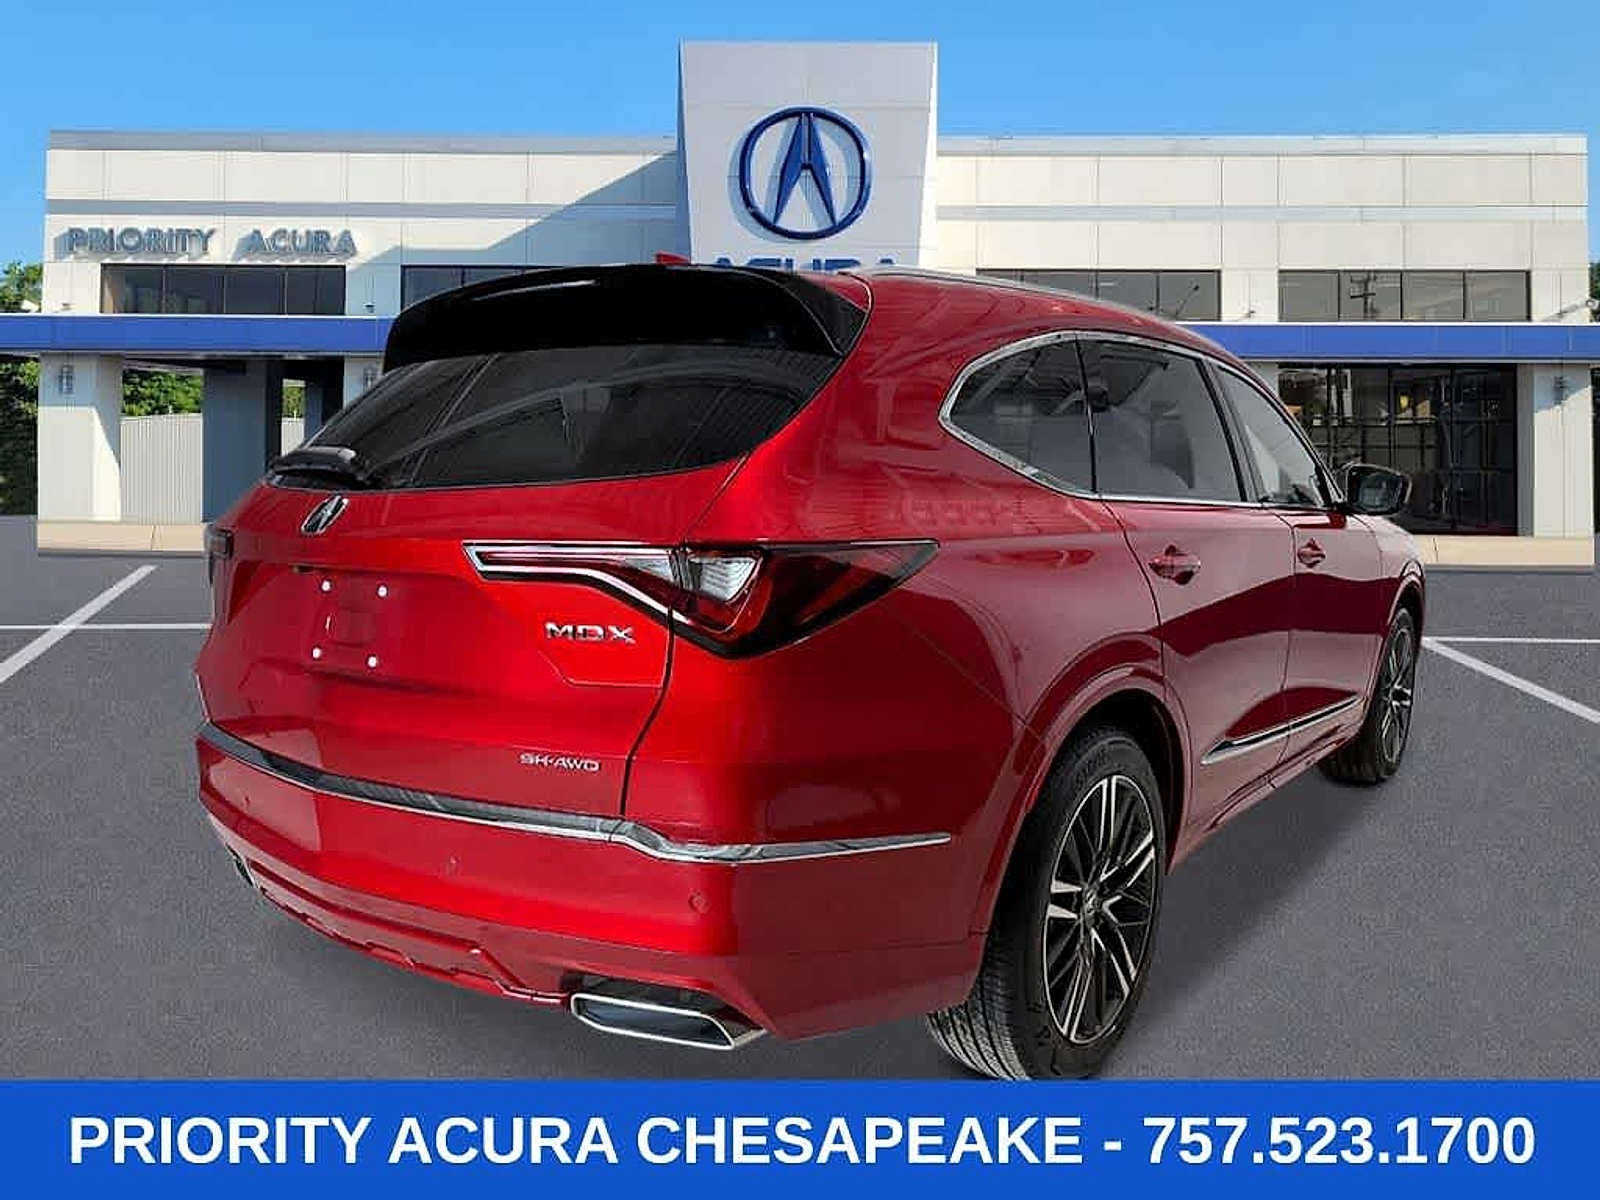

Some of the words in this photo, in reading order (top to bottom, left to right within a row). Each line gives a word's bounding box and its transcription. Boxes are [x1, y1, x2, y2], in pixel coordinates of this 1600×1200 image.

[67, 227, 215, 253] PRIORITY
[247, 229, 357, 254] ACURA
[545, 622, 637, 644] MDX
[519, 752, 600, 772] SH-AWD
